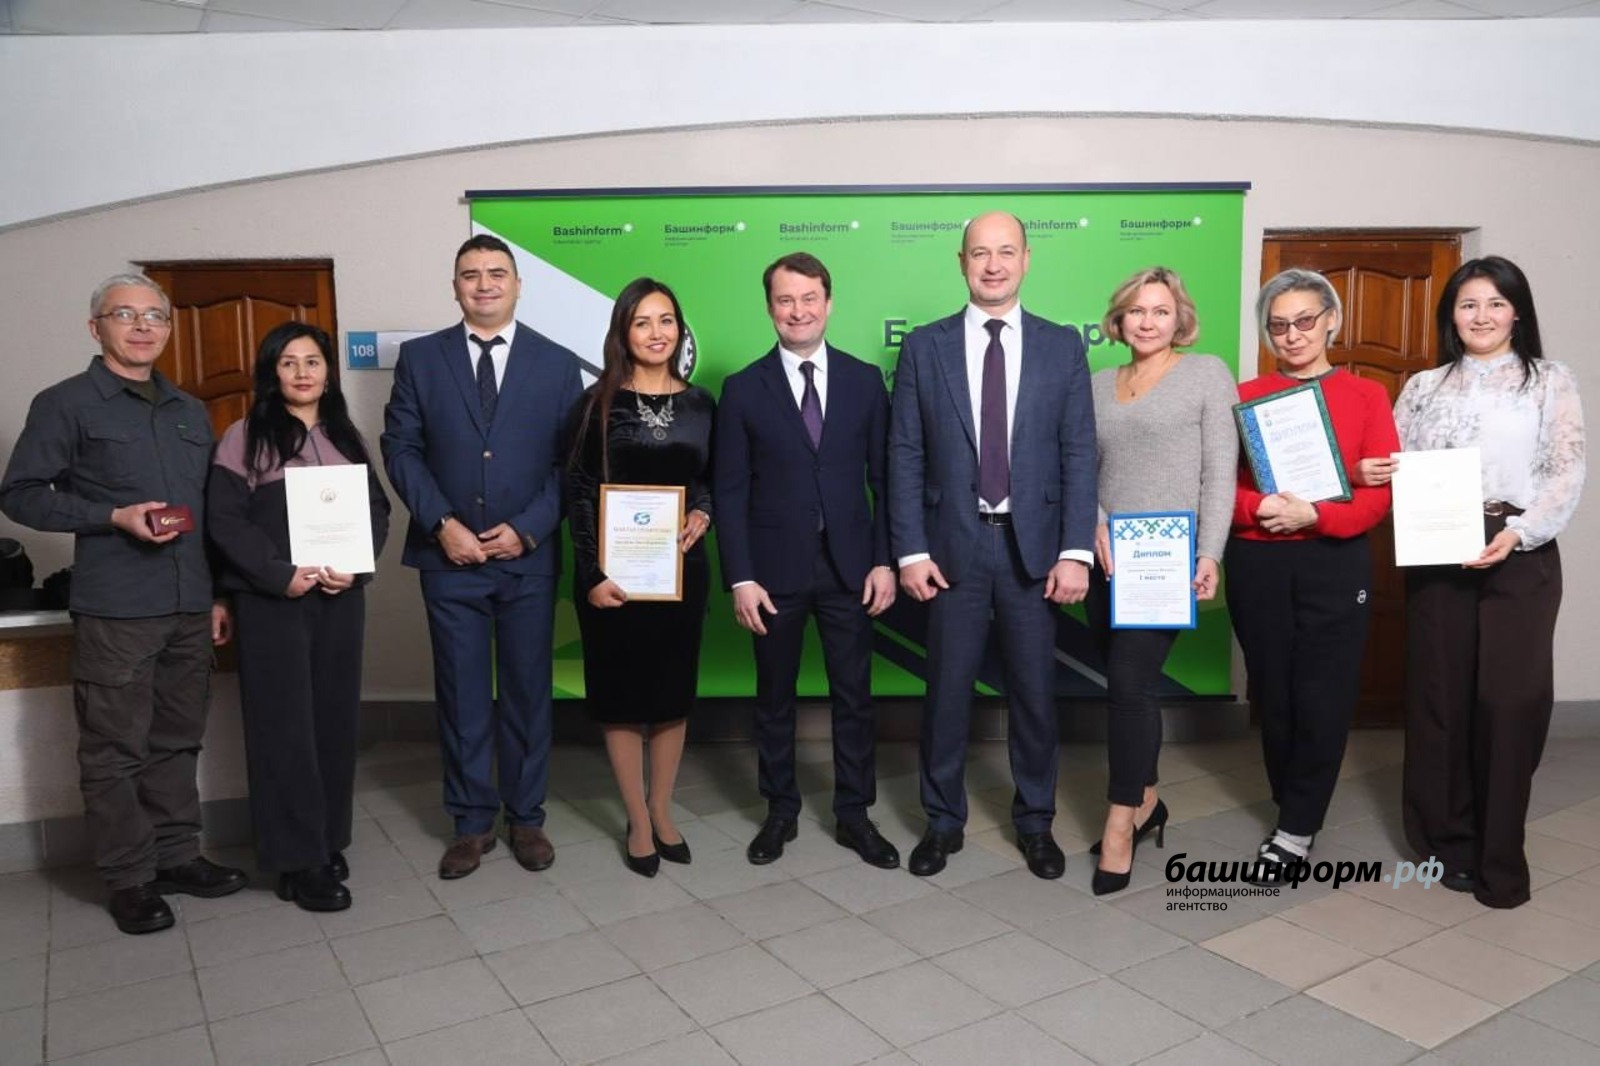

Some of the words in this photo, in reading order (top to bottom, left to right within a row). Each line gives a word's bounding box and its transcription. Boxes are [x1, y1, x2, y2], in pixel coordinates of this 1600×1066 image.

[664, 223, 735, 234] Башинформ
[779, 222, 849, 233] Bashinform
[891, 220, 962, 232] Башинформ
[1024, 219, 1077, 229] shinform
[1120, 218, 1191, 229] Башинформ
[553, 225, 622, 236] Bashinform
[351, 344, 375, 357] 108
[1133, 550, 1171, 559] Диплом
